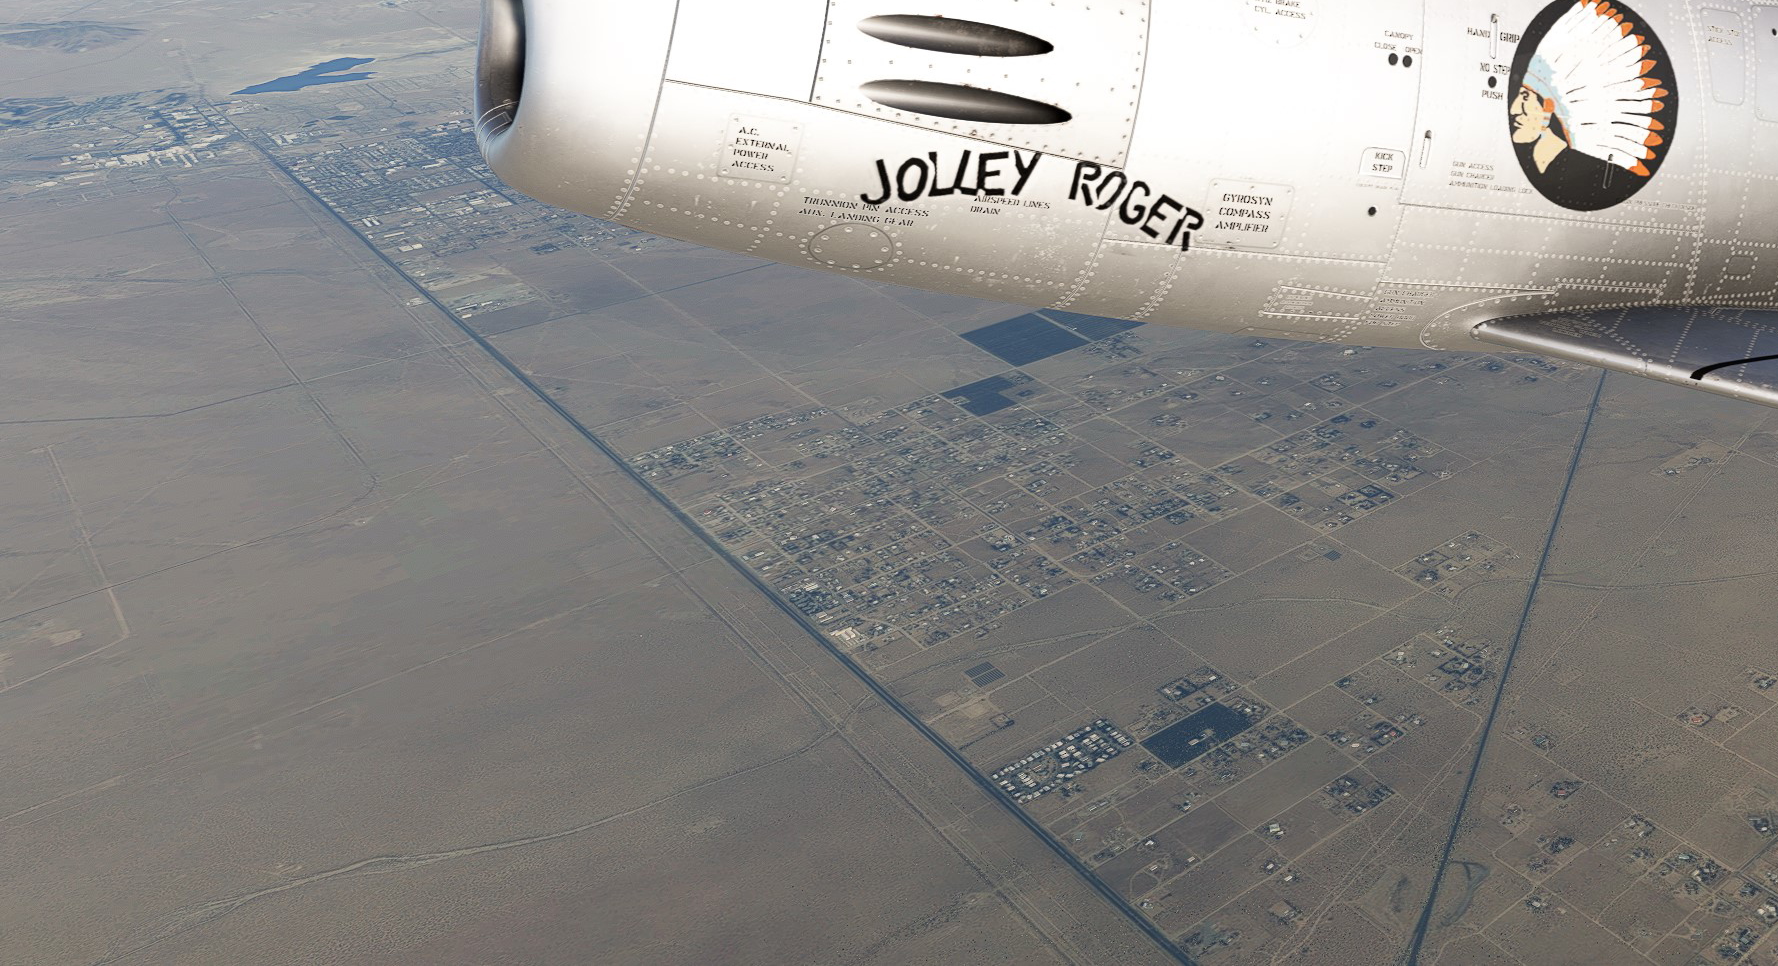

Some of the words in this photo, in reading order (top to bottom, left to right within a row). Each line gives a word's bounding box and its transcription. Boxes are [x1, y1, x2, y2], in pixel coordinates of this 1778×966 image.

[1275, 9, 1306, 19] ACCESS
[1384, 30, 1413, 41] CANOPY
[1467, 27, 1491, 38] HAND
[1500, 32, 1520, 44] GRIP
[1374, 42, 1397, 51] CLOSE
[1405, 46, 1422, 55] OPEN
[1480, 62, 1490, 73] NO
[1493, 64, 1511, 75] STEP
[1481, 90, 1504, 100] PUSH
[738, 127, 759, 136] A.C.
[735, 137, 790, 152] EXTERNAL
[733, 149, 768, 160] POWER
[1375, 151, 1394, 161] KICK
[731, 160, 774, 172] ACCESS
[1372, 163, 1393, 173] STEP
[1468, 162, 1494, 171] ACCESS
[860, 149, 1043, 205] JOLLEY
[1068, 160, 1204, 252] ROGER
[974, 195, 1020, 206] AIRSPEED
[1023, 200, 1051, 209] LINES
[1223, 193, 1273, 206] GYROSYN
[804, 196, 858, 210] TRUNNION
[862, 203, 880, 212] PIN
[885, 206, 930, 217] ACCESS
[970, 206, 1000, 215] DRAIN
[799, 208, 825, 217] AUX.
[830, 211, 880, 223] LANDING
[884, 217, 914, 227] GEAR
[1219, 207, 1271, 219] COMPASS
[1215, 221, 1269, 233] AMPLIFIER
